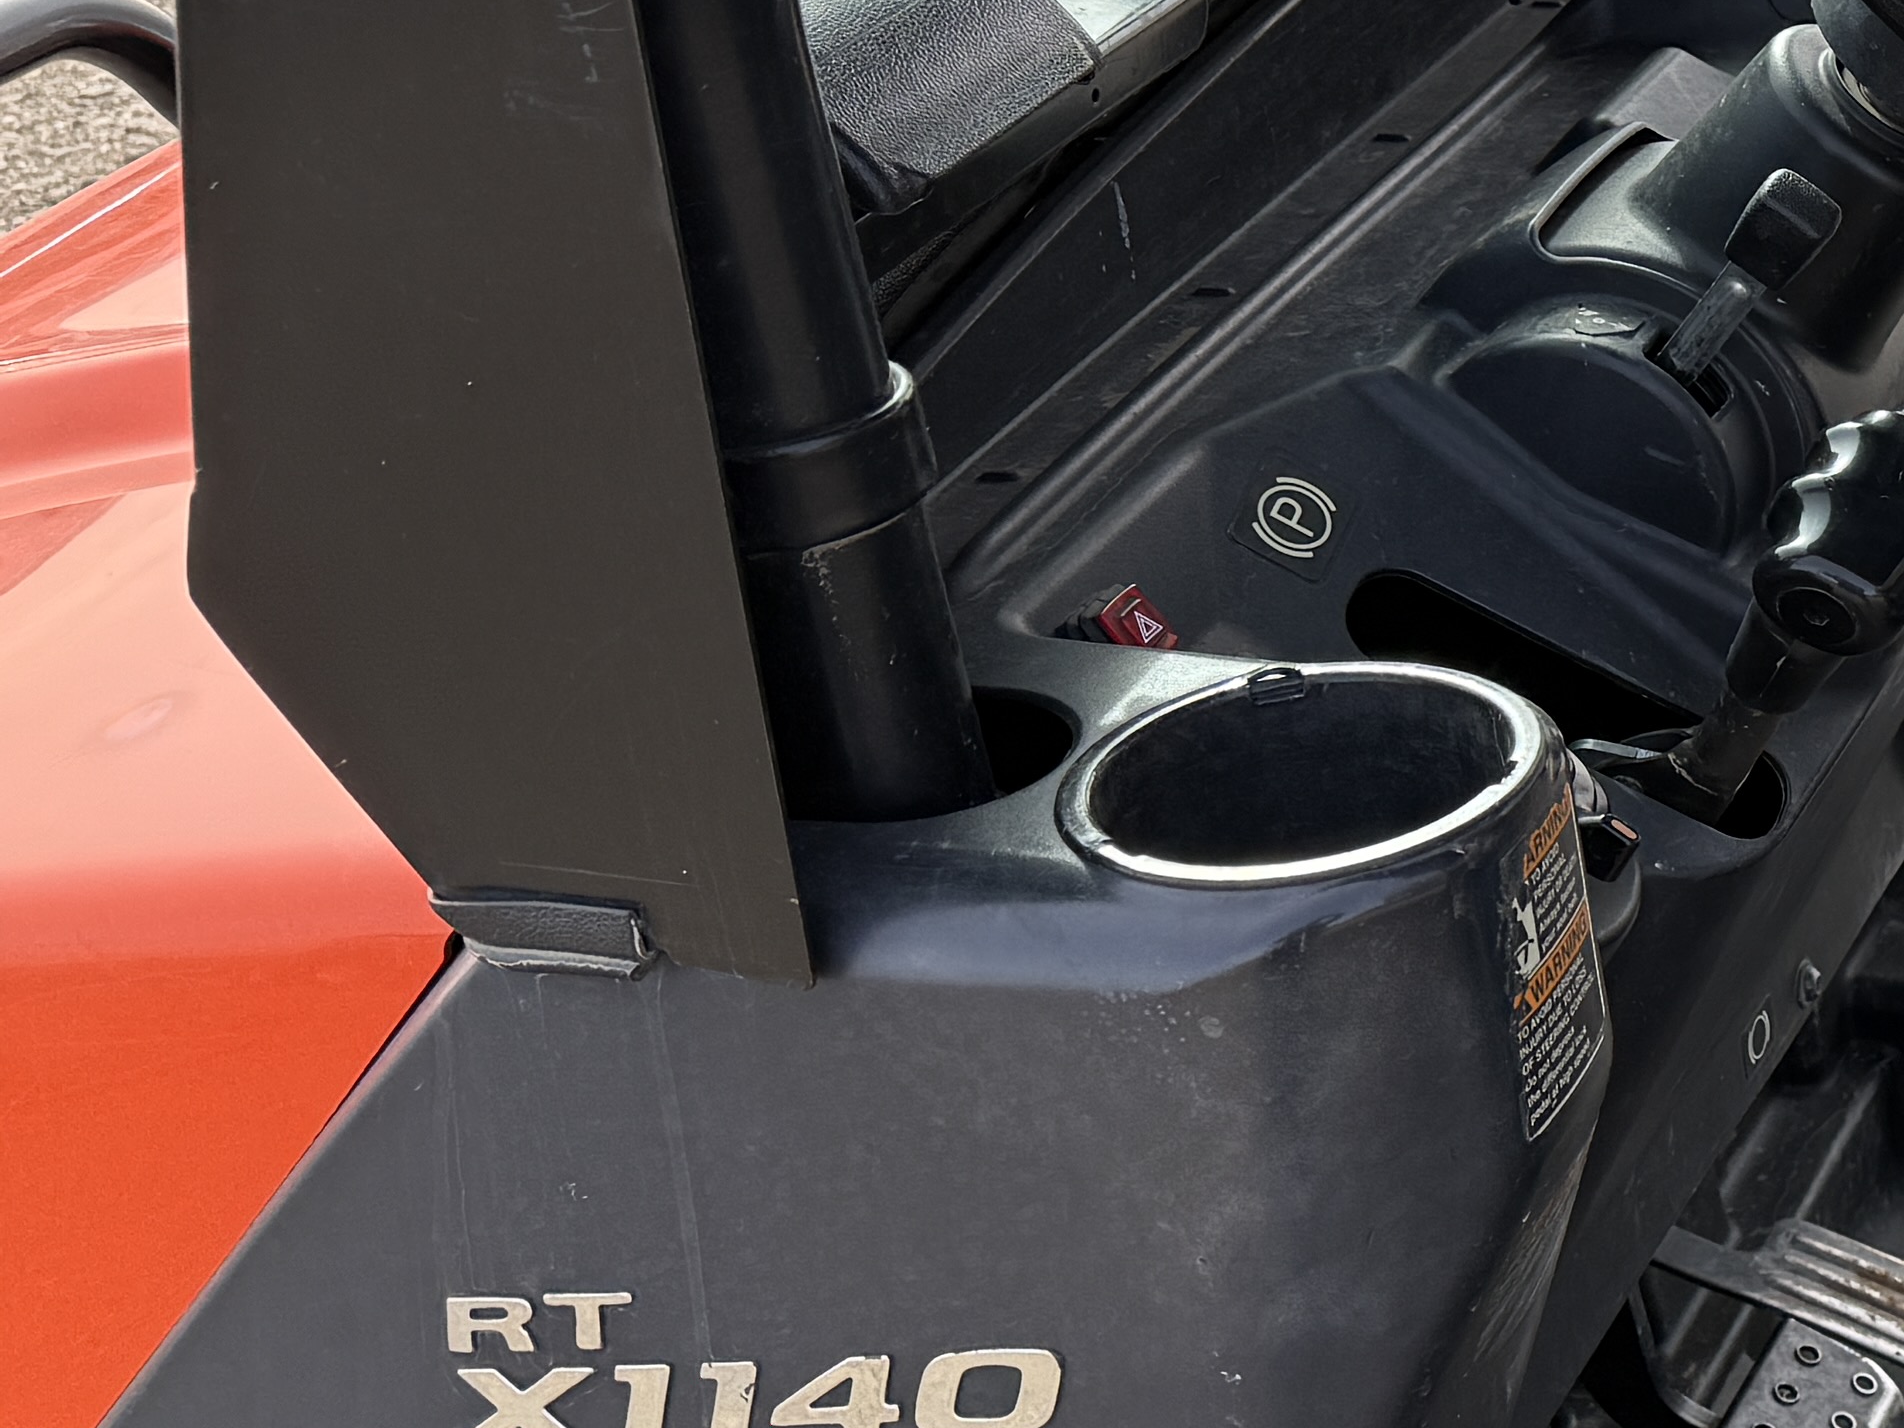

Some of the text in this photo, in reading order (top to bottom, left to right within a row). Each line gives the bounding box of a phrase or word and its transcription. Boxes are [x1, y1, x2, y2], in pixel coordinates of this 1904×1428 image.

[1530, 911, 1589, 1003] WARNING
[1519, 1024, 1547, 1061] INJURY
[1548, 1006, 1563, 1028] DUE
[1522, 1058, 1535, 1076] OF
[1535, 1014, 1570, 1064] STEERING
[1530, 998, 1553, 1032] AVOID
[446, 1291, 632, 1354] RT
